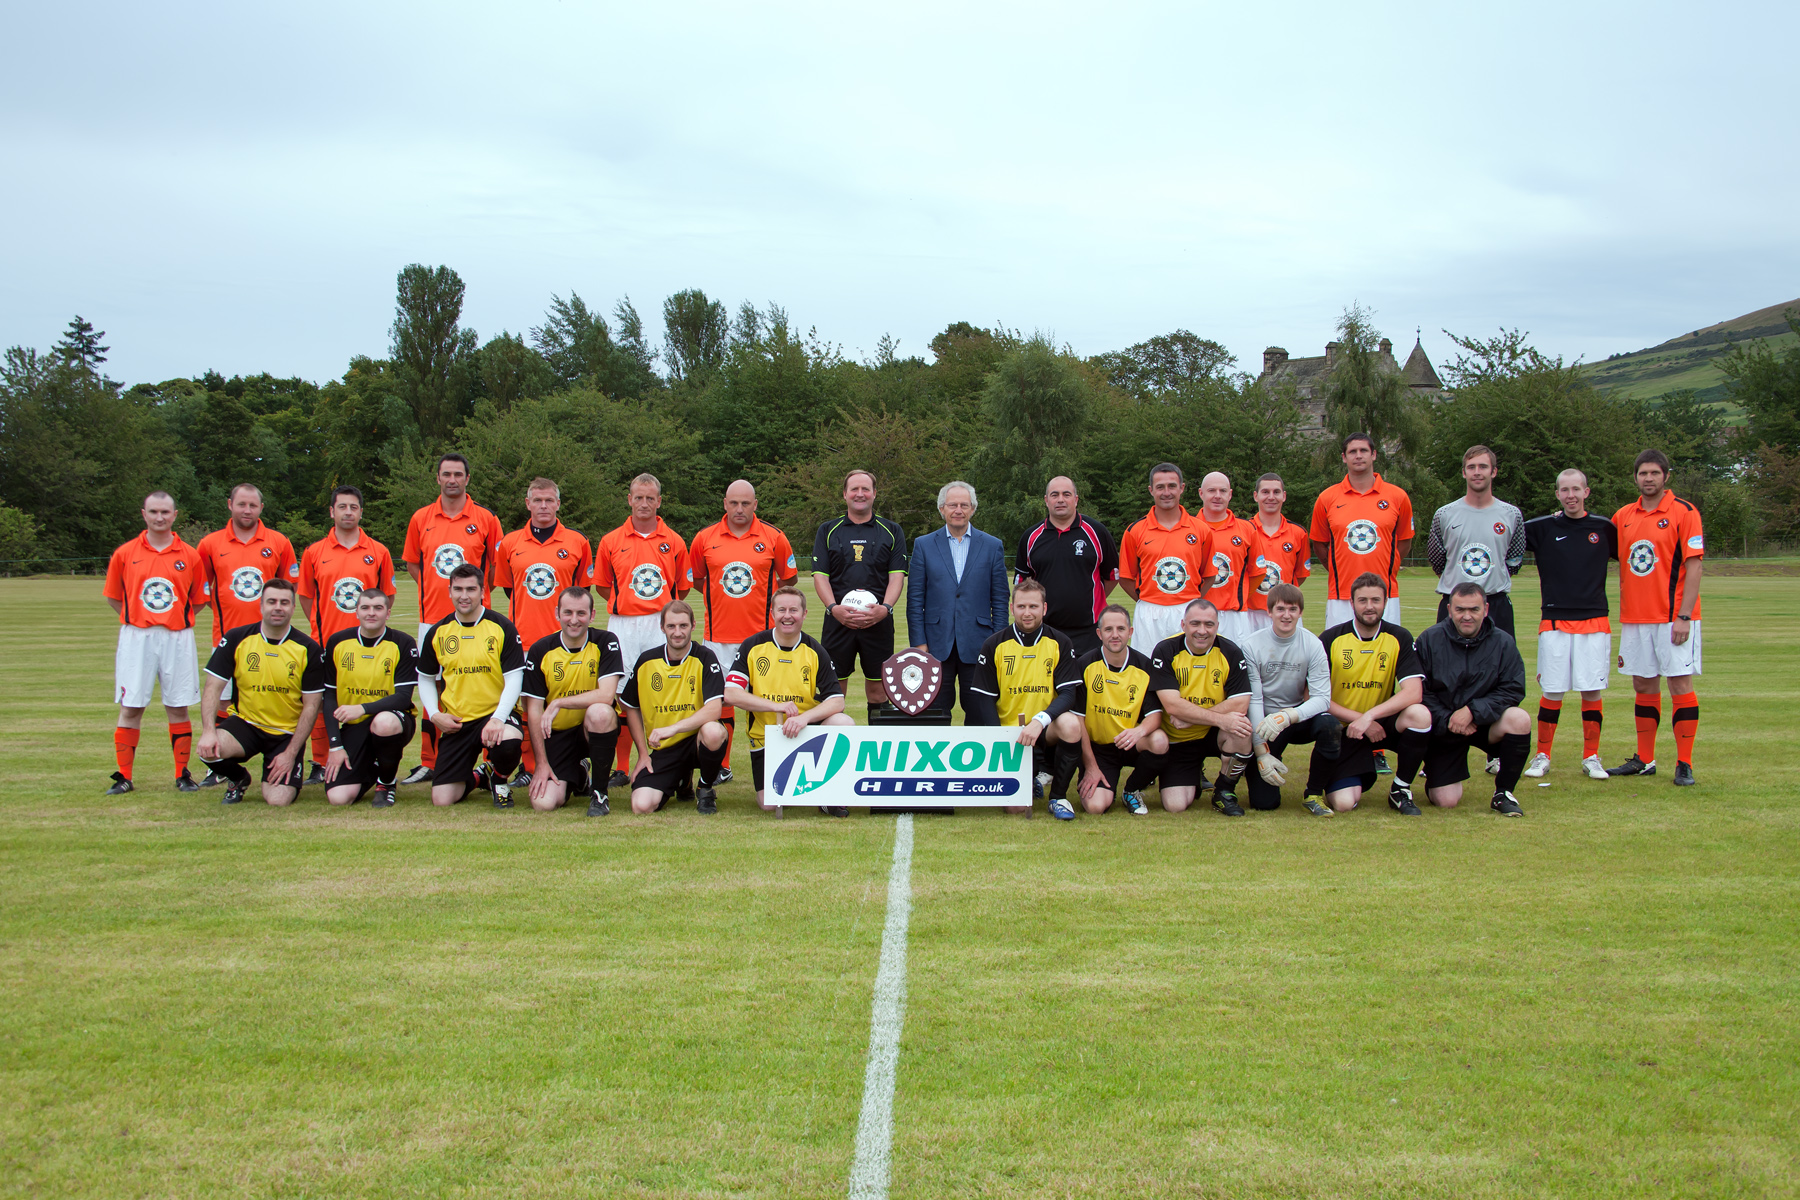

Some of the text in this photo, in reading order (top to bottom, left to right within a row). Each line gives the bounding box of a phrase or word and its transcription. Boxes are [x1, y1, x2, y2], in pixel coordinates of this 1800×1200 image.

[438, 634, 460, 655] 10
[246, 652, 260, 672] 2
[341, 652, 355, 671] 4
[756, 656, 770, 676] 9
[1004, 655, 1016, 676] 7
[1342, 649, 1353, 669] 3
[554, 662, 564, 681] 5
[651, 672, 663, 692] 8
[1092, 674, 1104, 693] 6
[669, 704, 695, 712] GILMARTIN
[777, 695, 804, 703] GILMARTIN
[855, 741, 1024, 772] NIXON
[860, 782, 965, 792] HIRE
